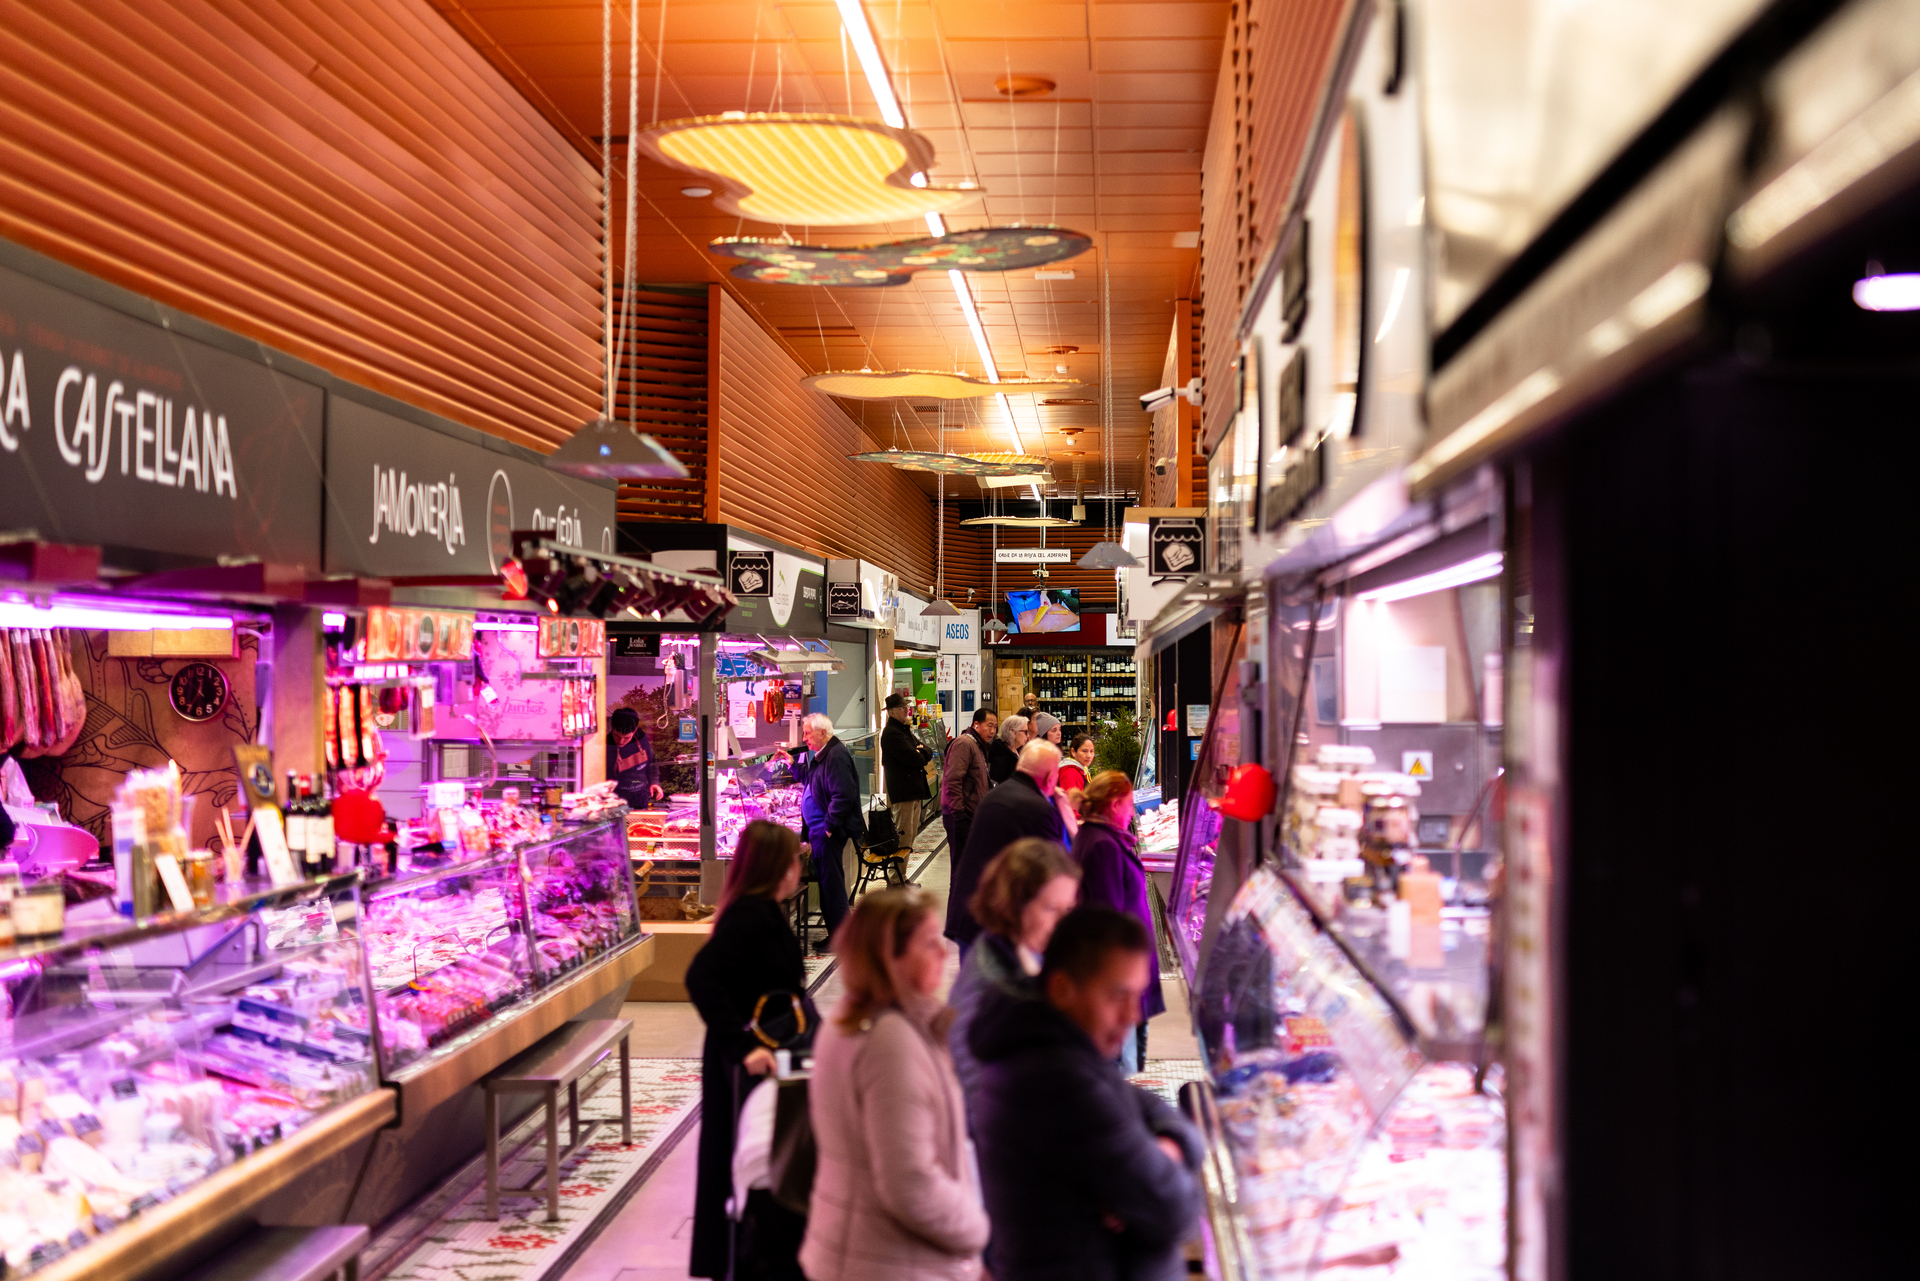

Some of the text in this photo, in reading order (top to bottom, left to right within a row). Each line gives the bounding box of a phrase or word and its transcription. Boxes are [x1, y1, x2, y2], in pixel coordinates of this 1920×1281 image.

[54, 365, 237, 499] CASTELLANA
[369, 463, 466, 555] JAMONERÍA
[946, 623, 969, 639] ASEOS
[214, 676, 220, 686] 2
[177, 687, 183, 695] 9
[216, 687, 222, 696] 3
[179, 697, 185, 705] 8
[213, 697, 219, 706] 4
[196, 707, 203, 716] 6
[206, 704, 213, 713] 5
